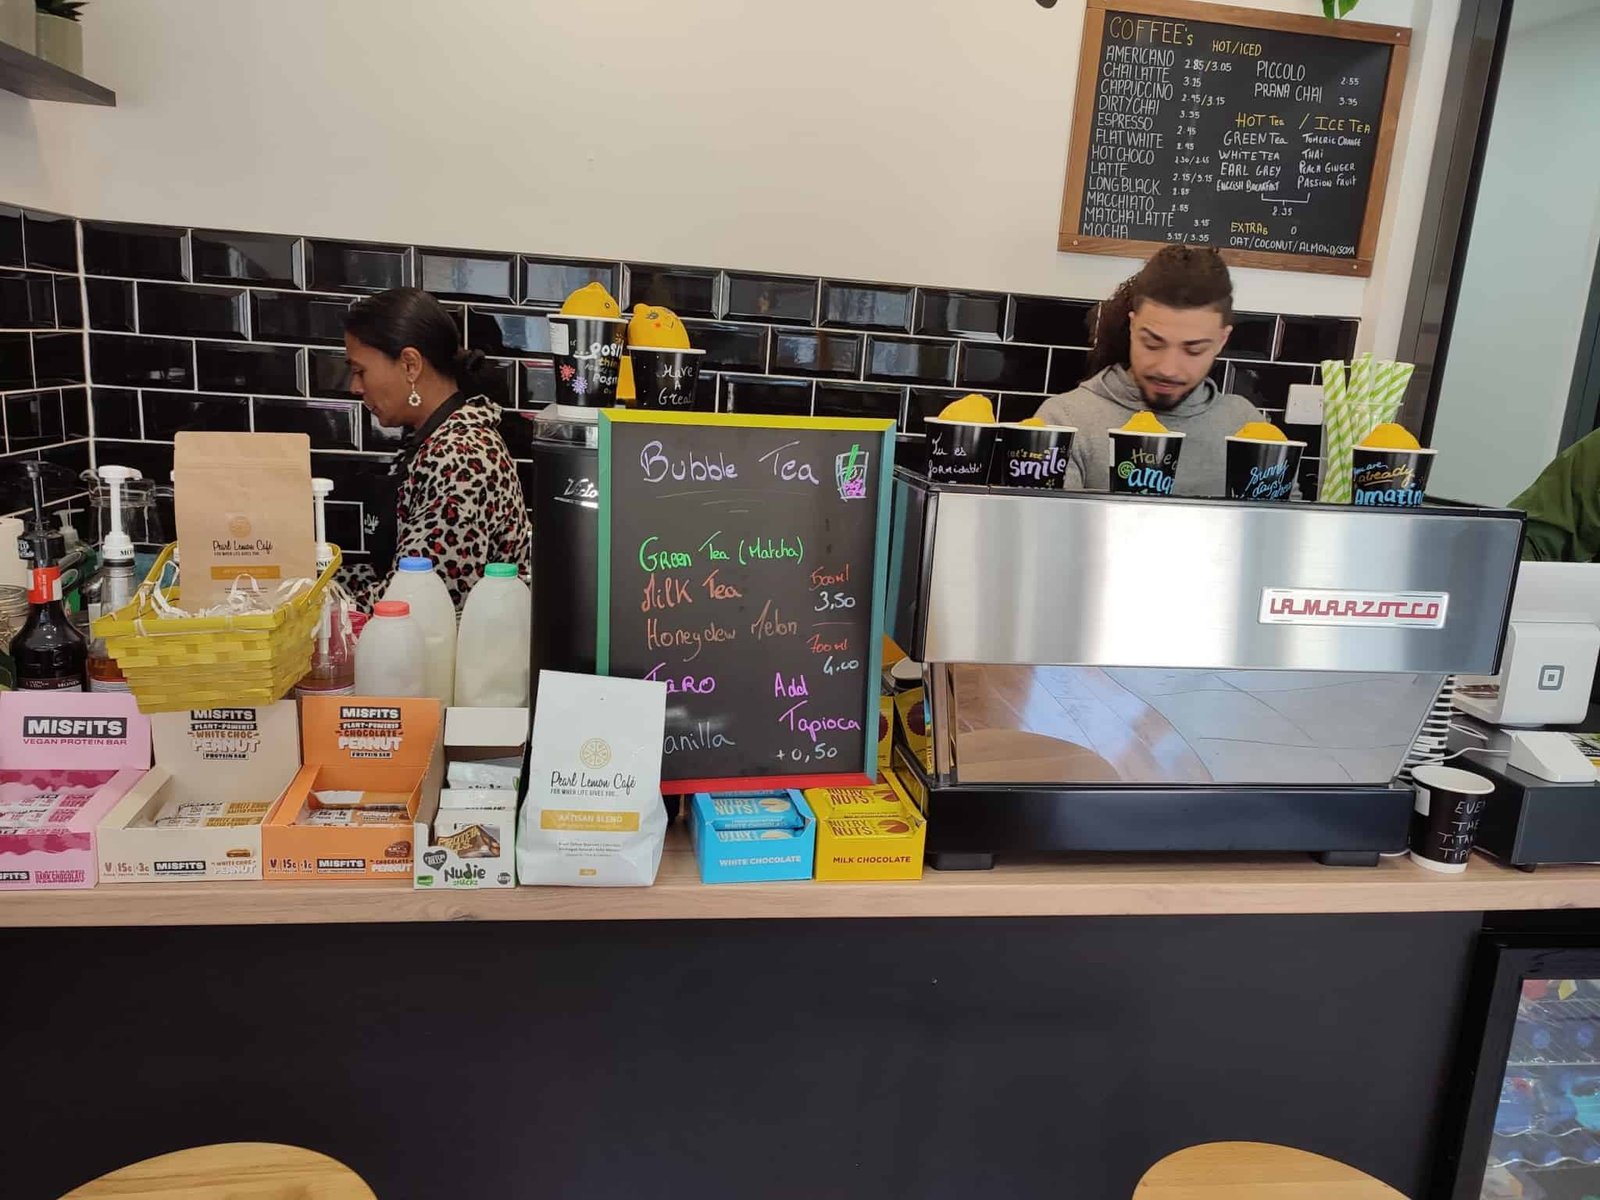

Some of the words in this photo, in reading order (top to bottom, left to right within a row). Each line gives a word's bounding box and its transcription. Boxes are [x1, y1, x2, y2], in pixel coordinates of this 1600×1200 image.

[1106, 45, 1175, 67] AMERICANO
[1103, 62, 1132, 79] CHAI
[1135, 66, 1171, 83] LATTE
[1256, 60, 1306, 81] PICCOLO
[1100, 79, 1174, 101] CAPPUCCINO
[1254, 82, 1291, 99] PRANA
[1295, 85, 1323, 104] CHAI
[1098, 95, 1133, 112] DIRTY
[1132, 98, 1160, 116] CHAI
[1097, 112, 1154, 131] ESPRESSO
[1235, 112, 1266, 128] HOT
[1314, 116, 1345, 131] ICE
[1095, 128, 1126, 146] FLAT
[1127, 131, 1164, 149] WHITE
[1224, 130, 1267, 146] GREEN
[1092, 144, 1116, 160] HOT
[1116, 147, 1155, 165] CHOCO
[1090, 160, 1129, 178] LATTE
[1220, 162, 1250, 176] EARL
[1255, 164, 1281, 178] GREY
[1088, 176, 1120, 192] LONG
[1121, 177, 1162, 196] BLACK
[1086, 191, 1155, 212] MACCHIATO
[1084, 206, 1135, 225] MATCHA
[1136, 211, 1175, 228] LATTE
[1082, 222, 1129, 239] MOCHA
[640, 440, 738, 483] Bubble
[758, 440, 820, 485] Tea
[1009, 447, 1067, 480] smile
[698, 530, 730, 561] Tea
[702, 568, 742, 600] Tea
[750, 599, 800, 641] Melon
[775, 671, 809, 698] Add
[193, 709, 255, 721] MISFITS
[342, 707, 400, 719] MISFITS
[778, 700, 861, 743] Tapioca
[27, 718, 124, 737] MISFITS
[196, 730, 226, 738] WHITE
[227, 730, 253, 739] CHOC
[344, 729, 397, 737] CHOCOLATE
[60, 738, 104, 746] PROTEIN
[664, 721, 737, 755] anilla
[550, 770, 577, 788] Pearl
[580, 772, 611, 789] Lemon
[613, 773, 637, 796] Café
[830, 794, 870, 806] NUTS
[831, 826, 873, 837] NUTS
[156, 862, 205, 871] MISFITS
[318, 859, 366, 868] MISFITS
[719, 858, 749, 867] WHITE
[749, 855, 802, 866] CHOCOLATE
[832, 856, 854, 864] MILK
[856, 855, 912, 864] CHOCOLATE
[443, 863, 487, 882] Nudie
